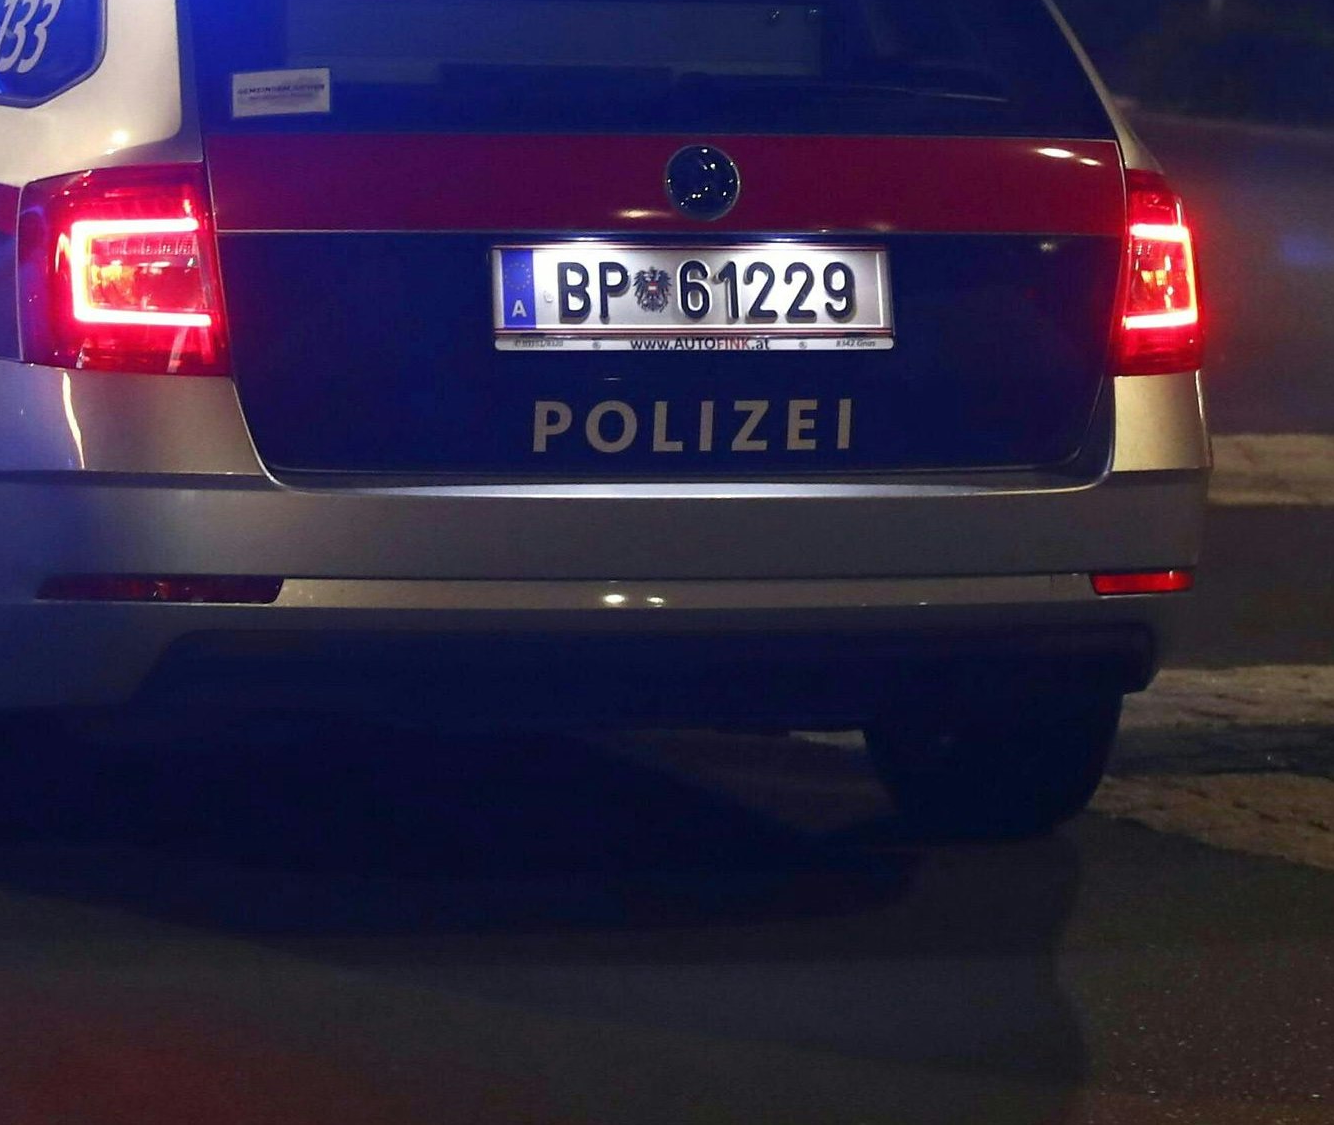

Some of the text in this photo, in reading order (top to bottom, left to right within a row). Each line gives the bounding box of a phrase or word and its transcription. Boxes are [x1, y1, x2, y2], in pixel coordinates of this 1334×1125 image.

[511, 300, 527, 318] A
[557, 260, 856, 324] BP 61229
[630, 337, 771, 351] www.AUTOFINK.at
[533, 398, 852, 453] POLIZEI
